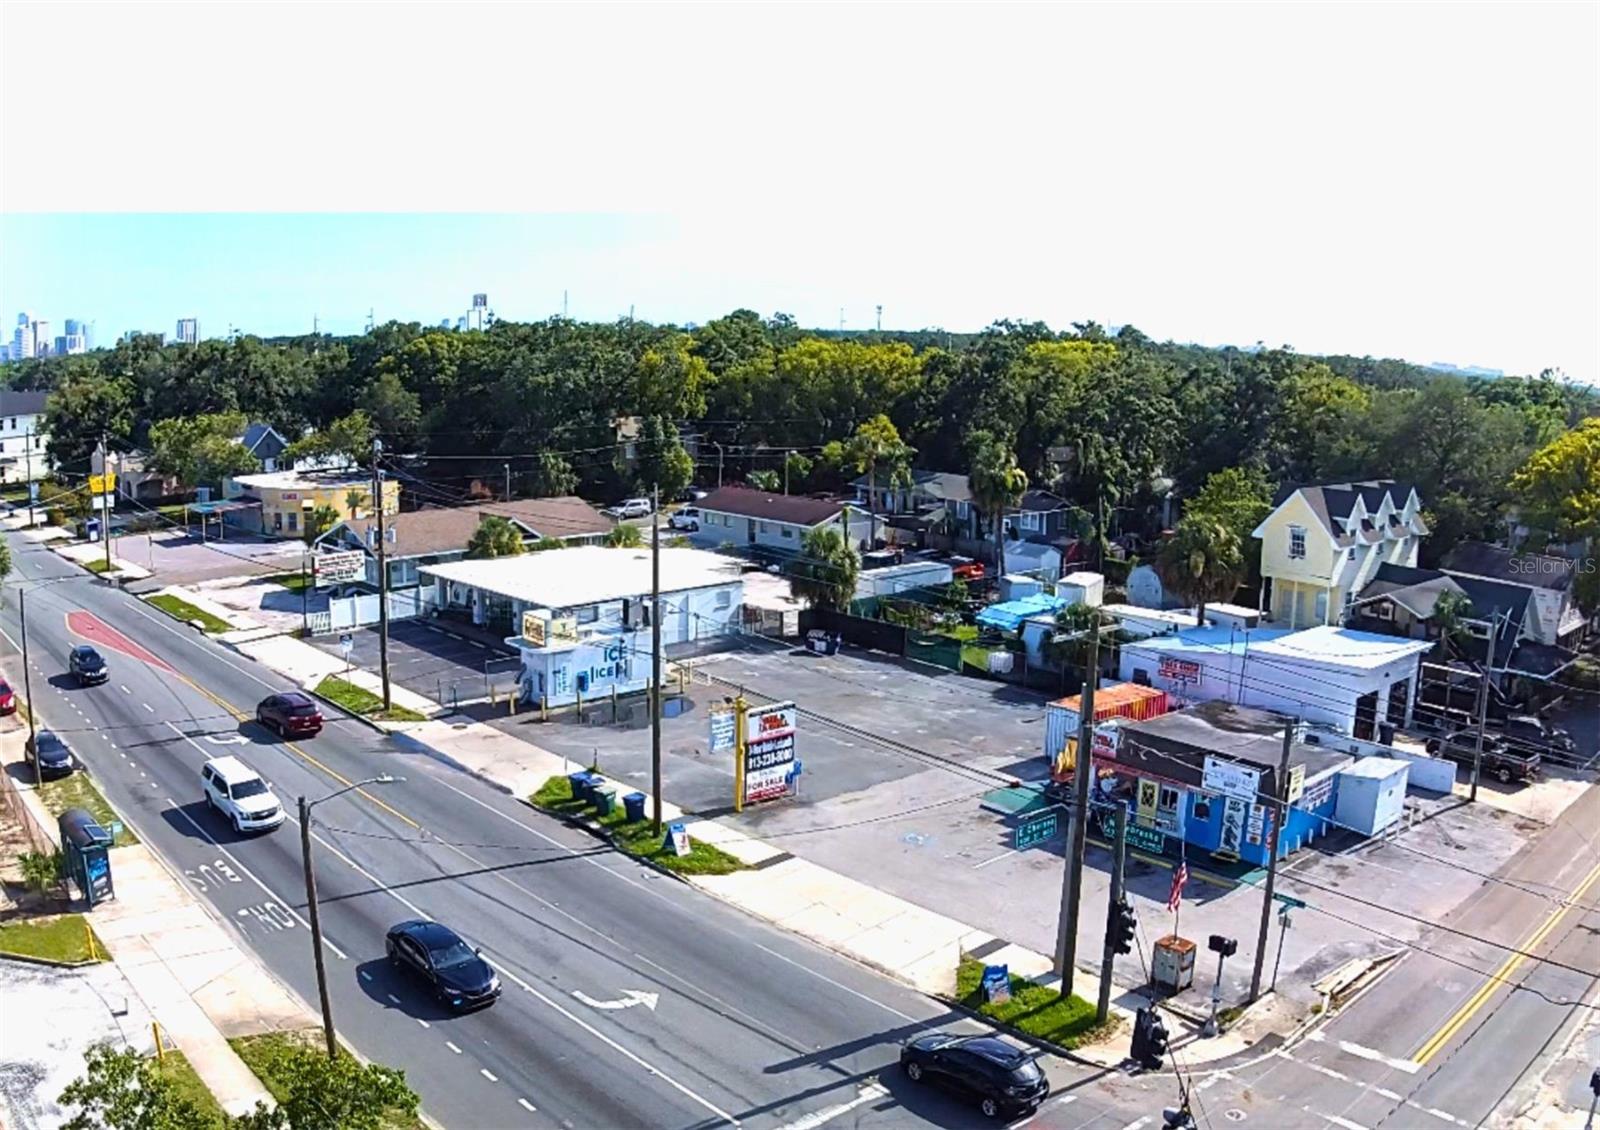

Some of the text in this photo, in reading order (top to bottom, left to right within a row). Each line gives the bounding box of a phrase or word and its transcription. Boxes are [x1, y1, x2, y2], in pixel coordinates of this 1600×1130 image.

[603, 645, 628, 662] ICE
[595, 666, 614, 679] ICE
[185, 859, 242, 892] BUS
